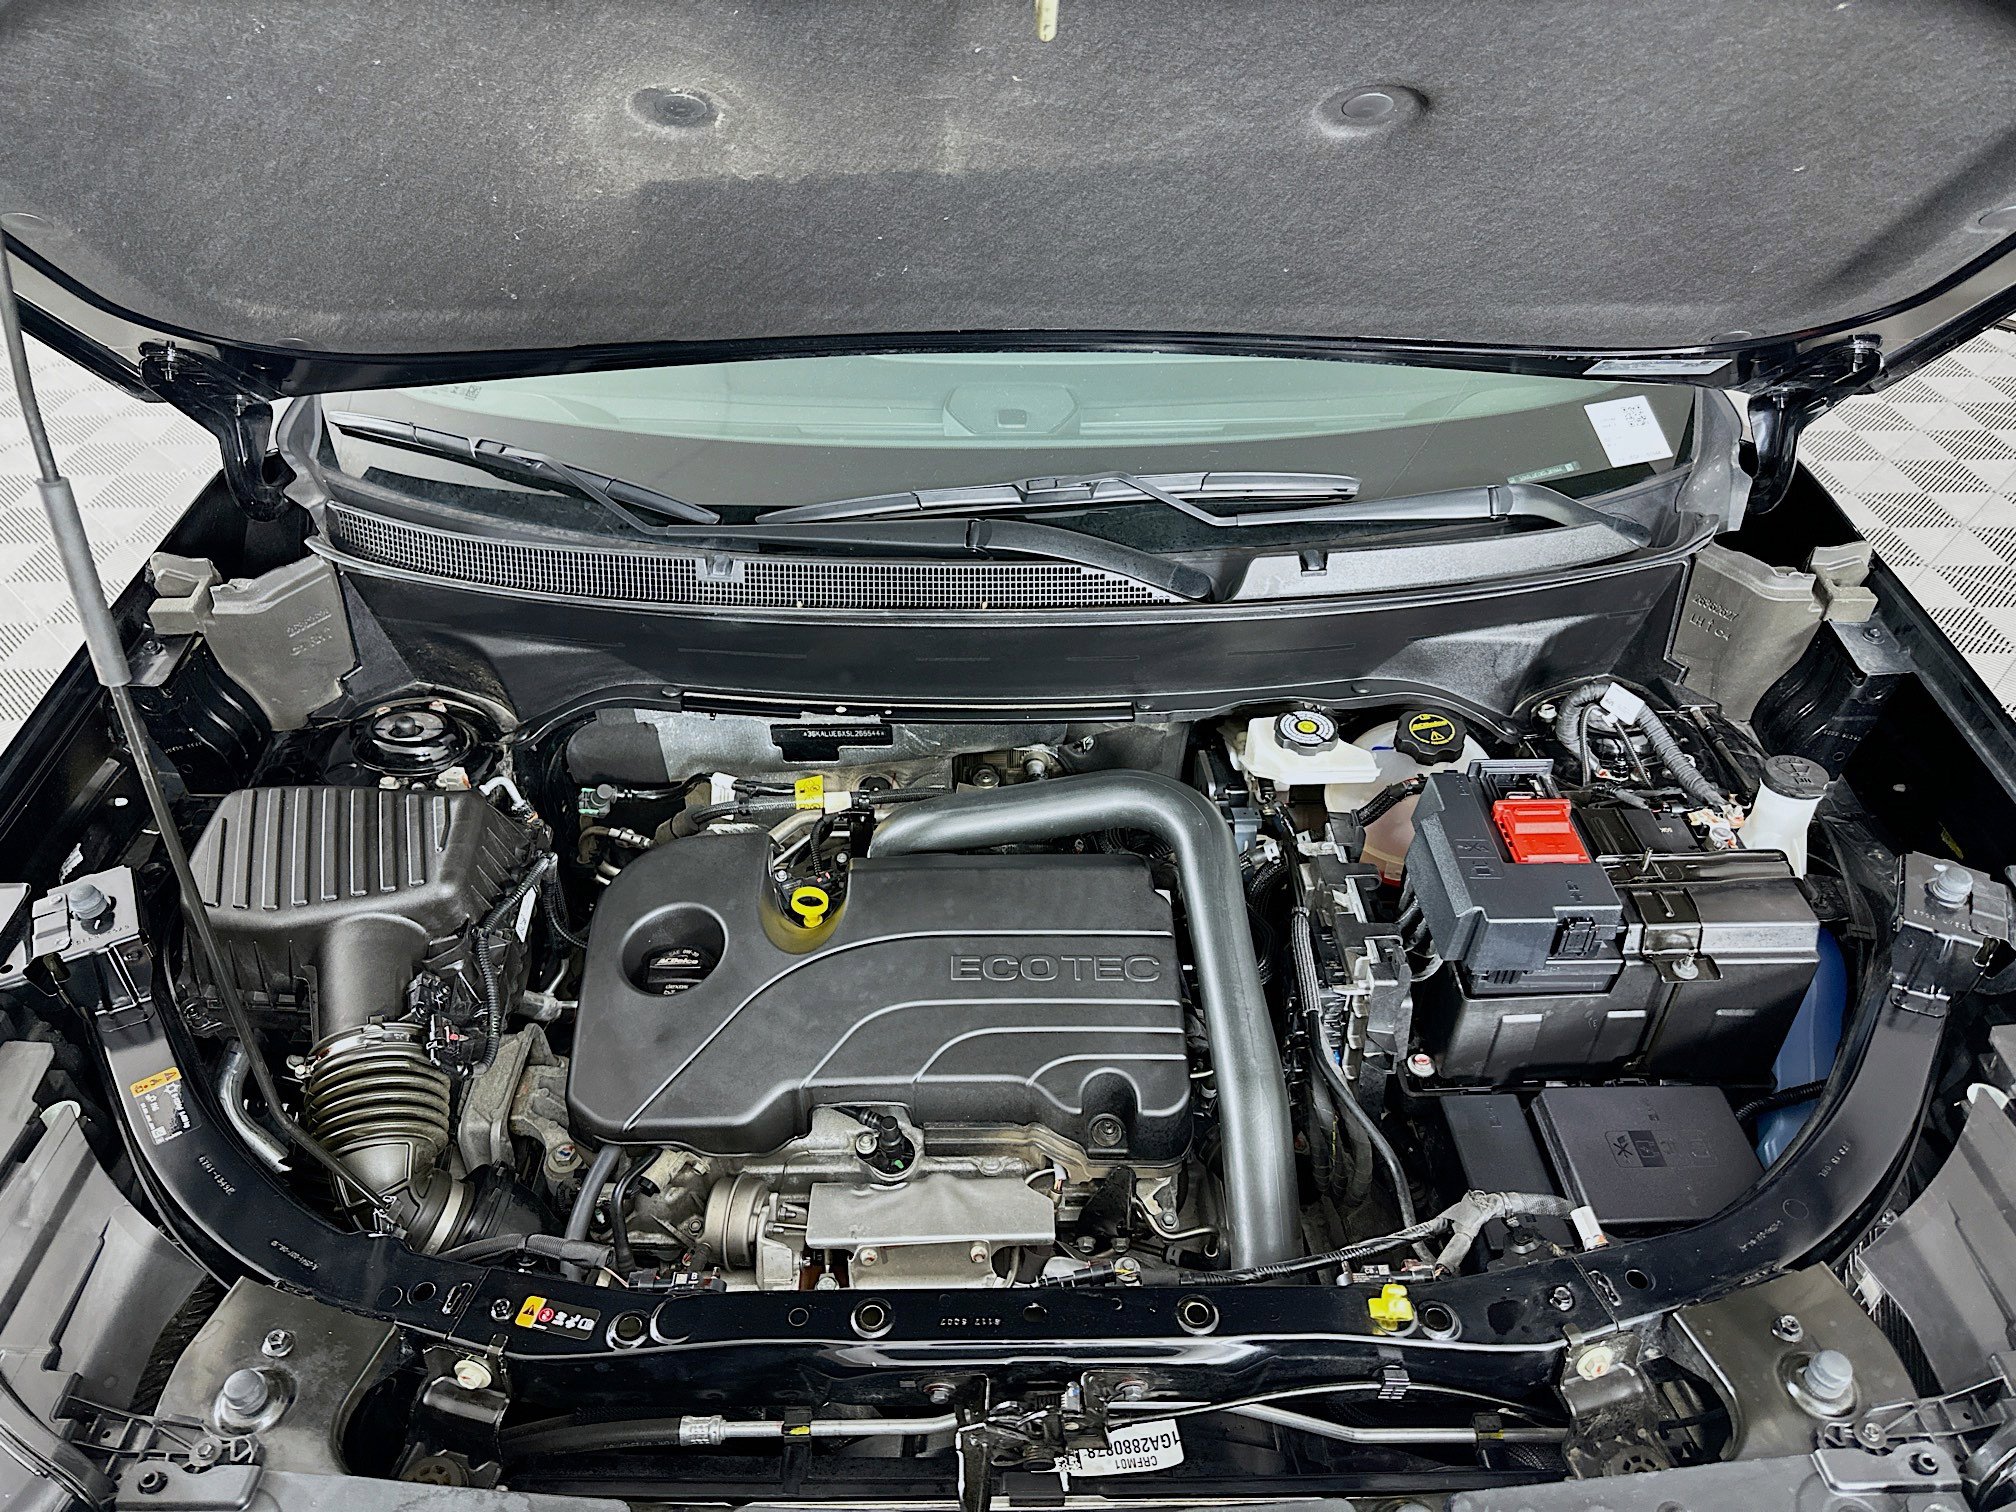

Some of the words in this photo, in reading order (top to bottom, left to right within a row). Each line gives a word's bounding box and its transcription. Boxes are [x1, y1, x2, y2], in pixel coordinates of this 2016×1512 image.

[656, 957, 699, 966] ACDelco
[950, 954, 1161, 982] ECOTEC
[1115, 1455, 1158, 1469] CRFM01
